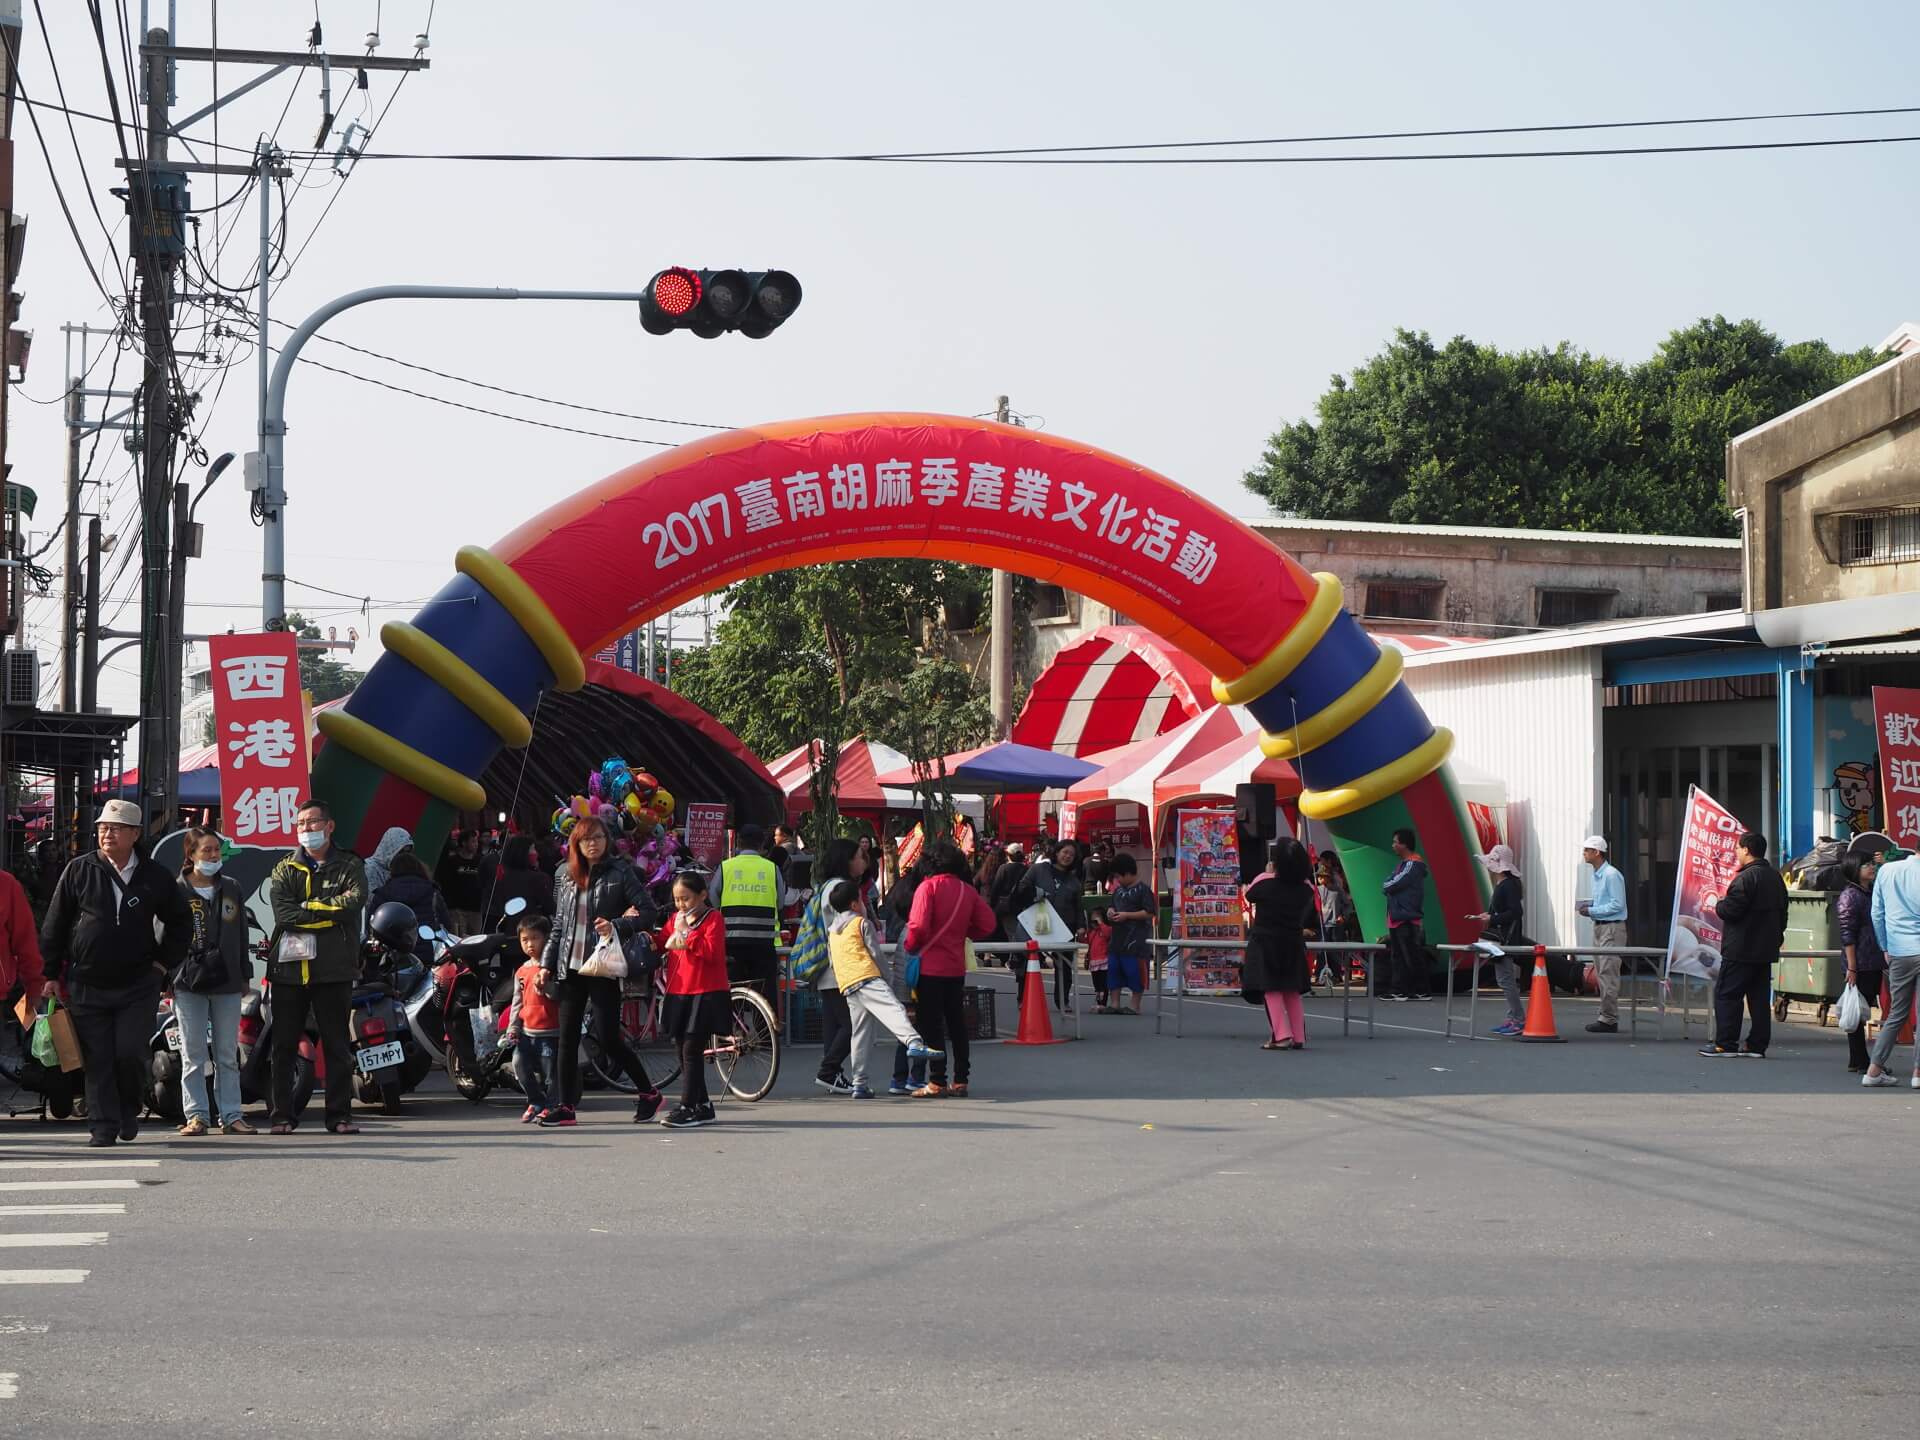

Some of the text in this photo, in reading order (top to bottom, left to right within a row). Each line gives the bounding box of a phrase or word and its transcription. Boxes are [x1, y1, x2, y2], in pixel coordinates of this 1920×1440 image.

[220, 656, 299, 837] 西港鄉
[731, 883, 768, 894] POLICE
